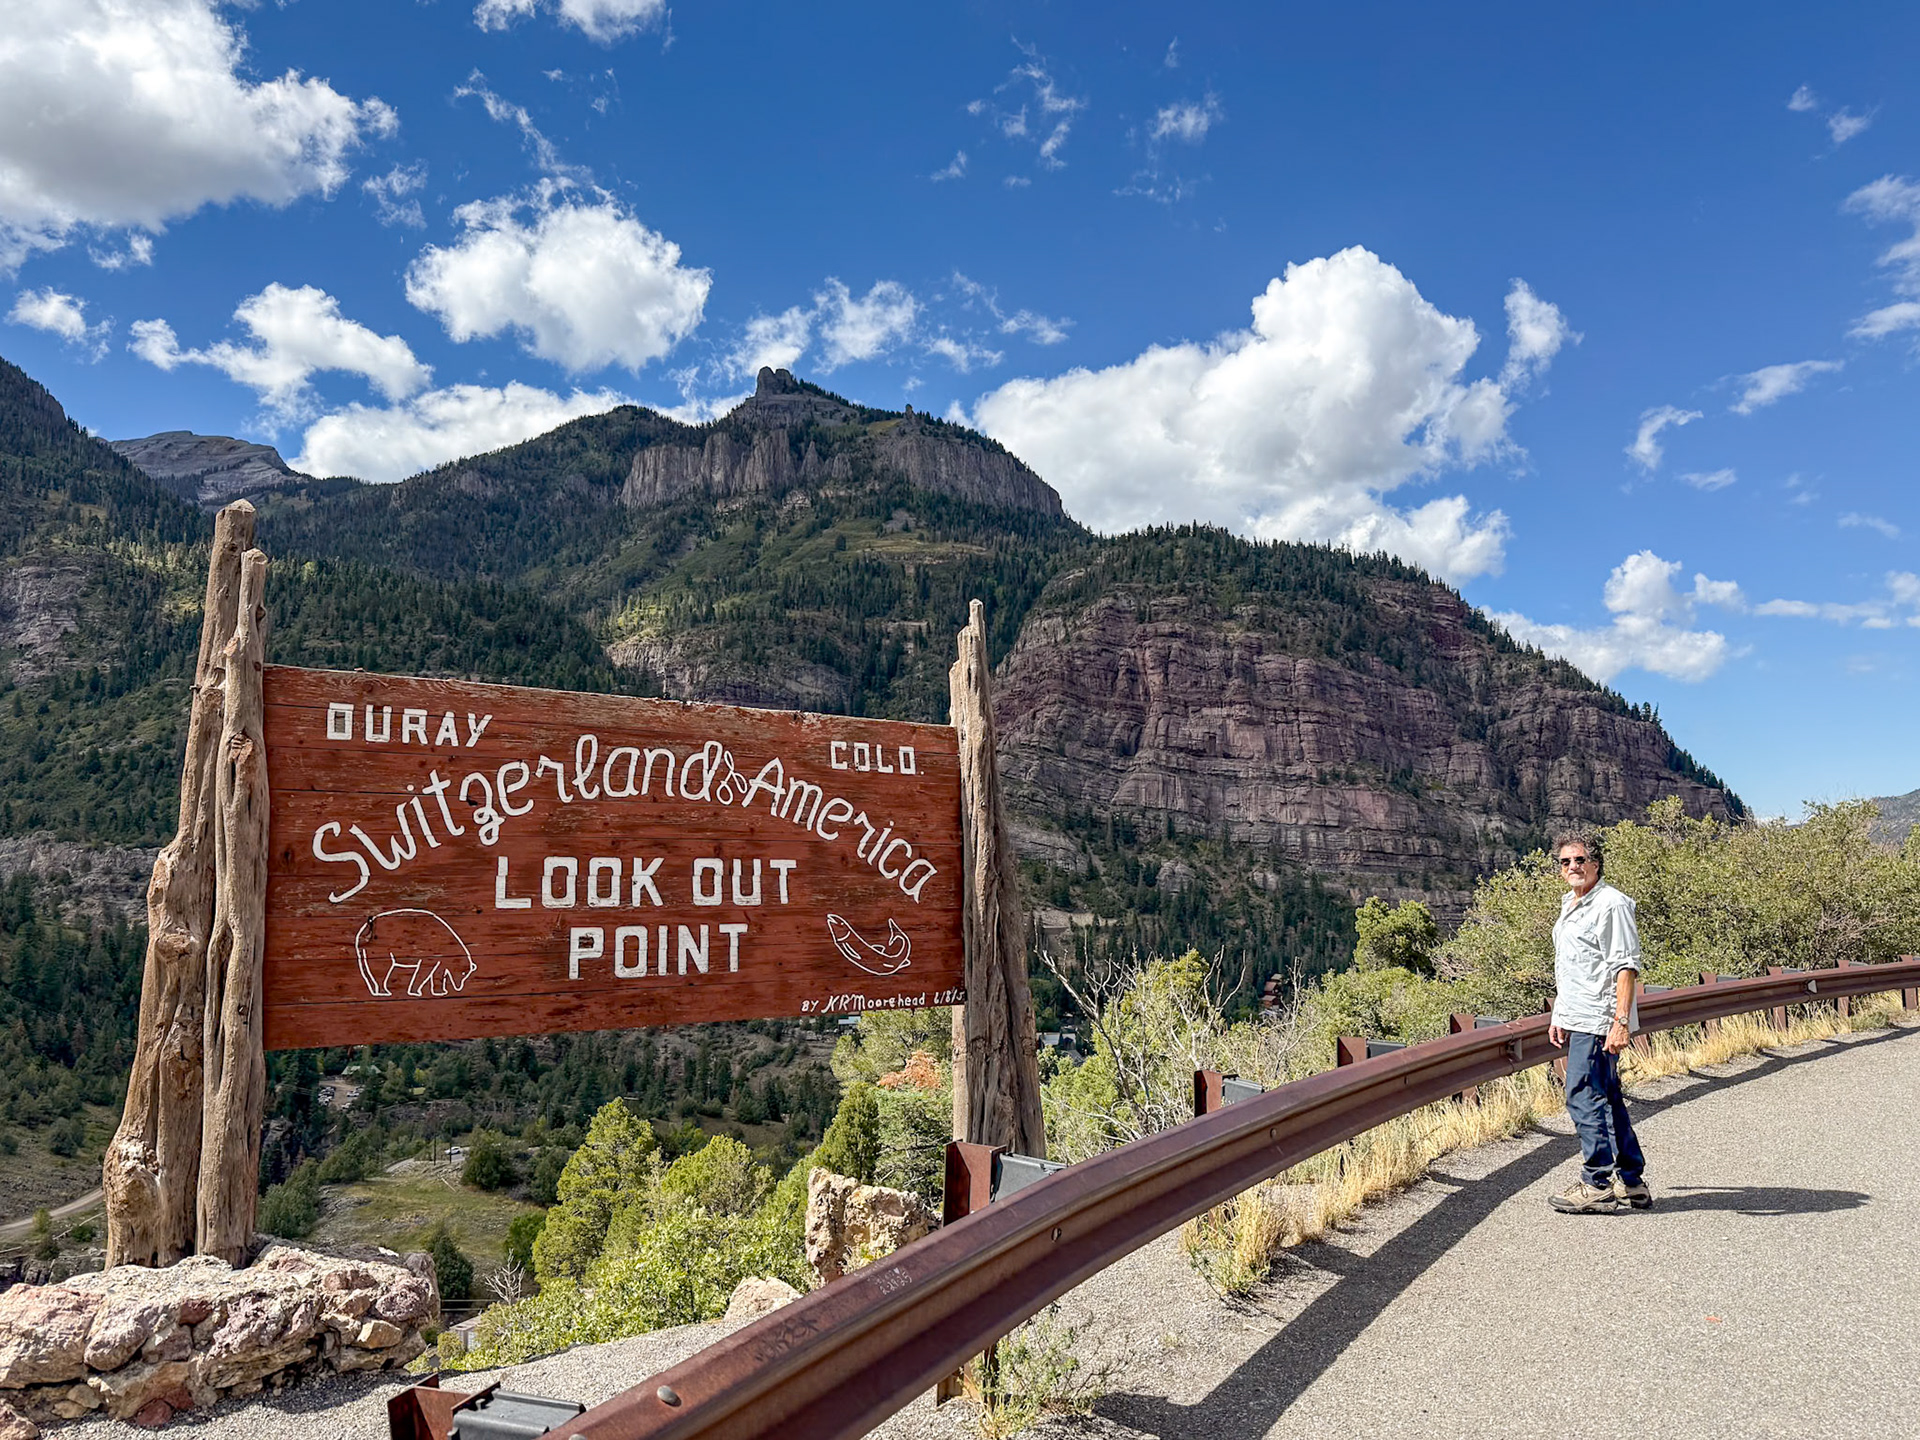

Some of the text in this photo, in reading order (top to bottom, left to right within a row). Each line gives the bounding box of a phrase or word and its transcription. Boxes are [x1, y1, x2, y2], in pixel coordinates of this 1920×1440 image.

[326, 702, 492, 748] OURAY
[830, 740, 924, 775] COLO.
[312, 733, 723, 903] Switzerland
[741, 757, 938, 904] America
[495, 856, 797, 909] LOOK OUT
[569, 924, 748, 979] POINT
[801, 1000, 819, 1013] BY
